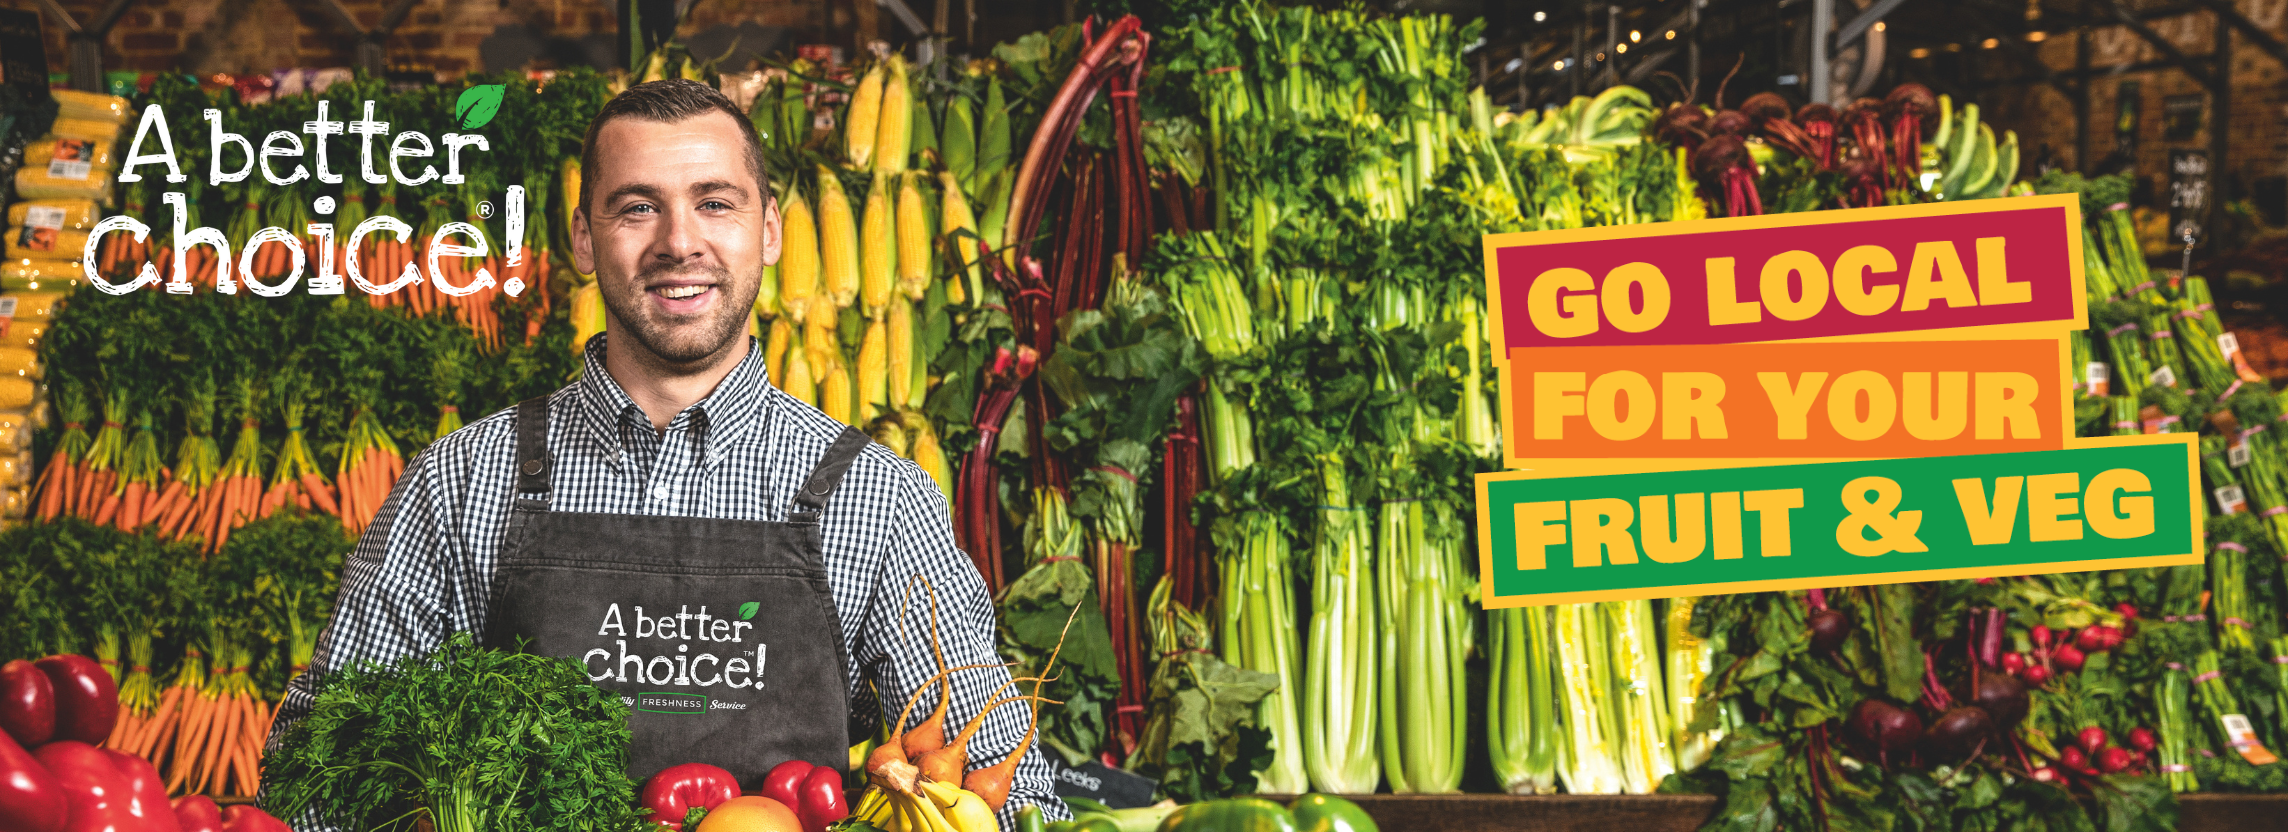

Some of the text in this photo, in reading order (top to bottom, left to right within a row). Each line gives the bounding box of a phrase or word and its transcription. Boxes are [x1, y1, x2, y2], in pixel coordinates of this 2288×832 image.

[598, 602, 753, 643] A better
[582, 639, 767, 690] choice!
[642, 698, 702, 708] FRESHNESS
[709, 699, 747, 710] Service
[1052, 758, 1102, 792] Leeks
